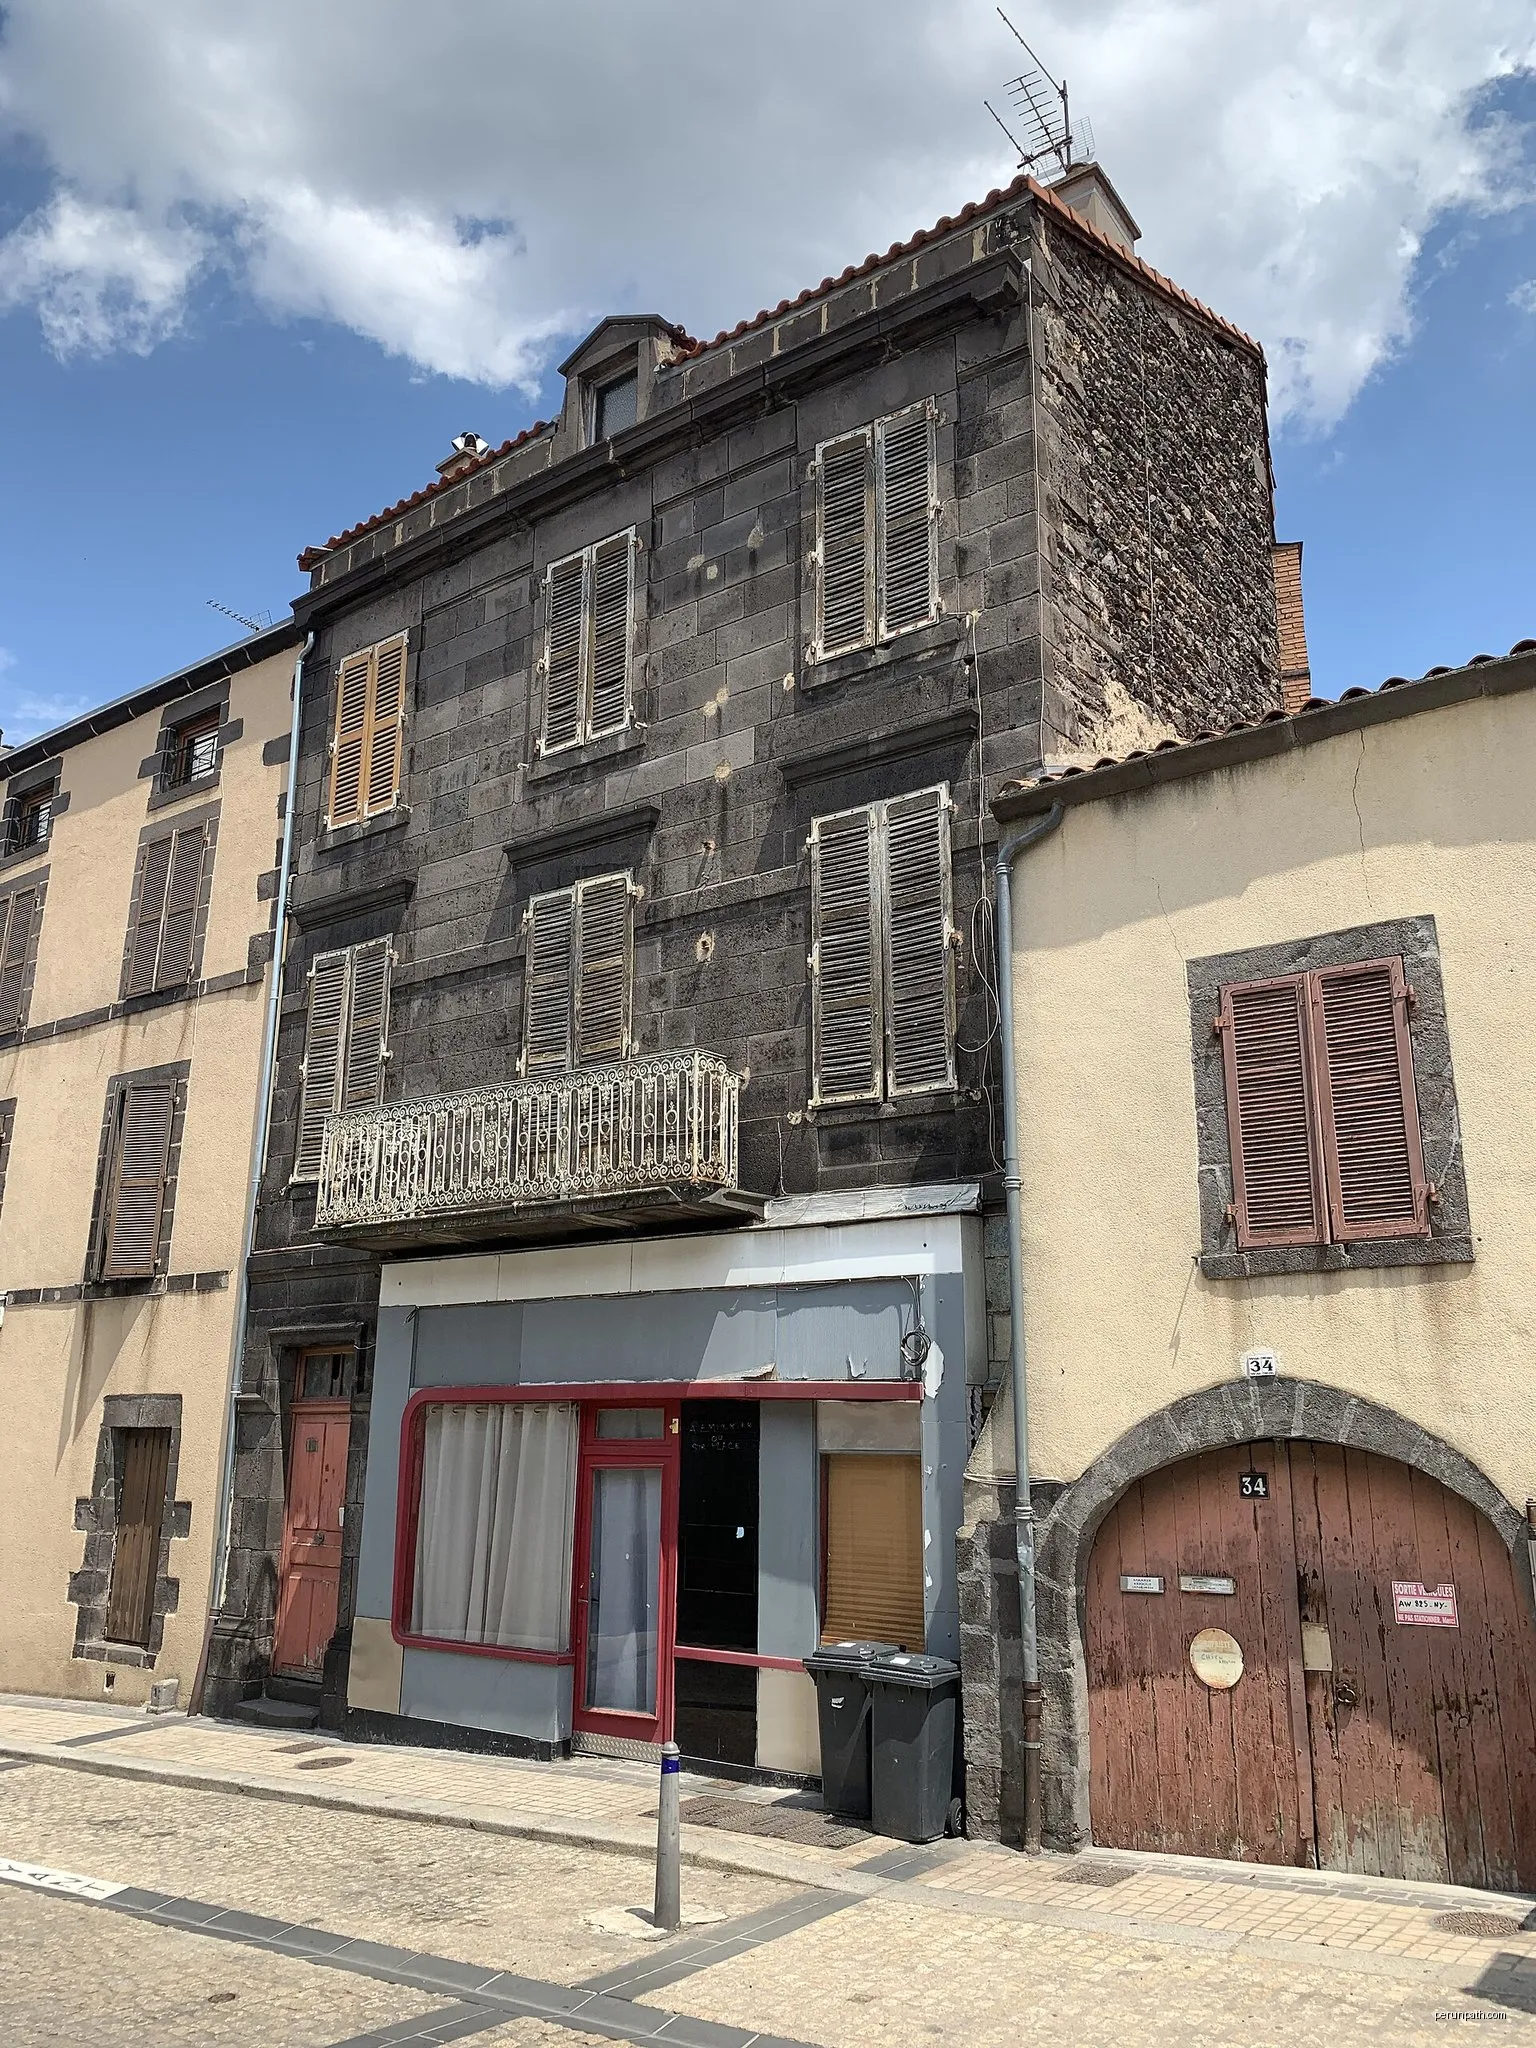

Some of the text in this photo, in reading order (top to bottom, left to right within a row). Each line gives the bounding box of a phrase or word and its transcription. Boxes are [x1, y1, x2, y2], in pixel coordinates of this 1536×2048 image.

[1250, 1360, 1273, 1372] 34
[1242, 1477, 1266, 1496] 34
[1394, 1584, 1453, 1598] SORTIE VECULES
